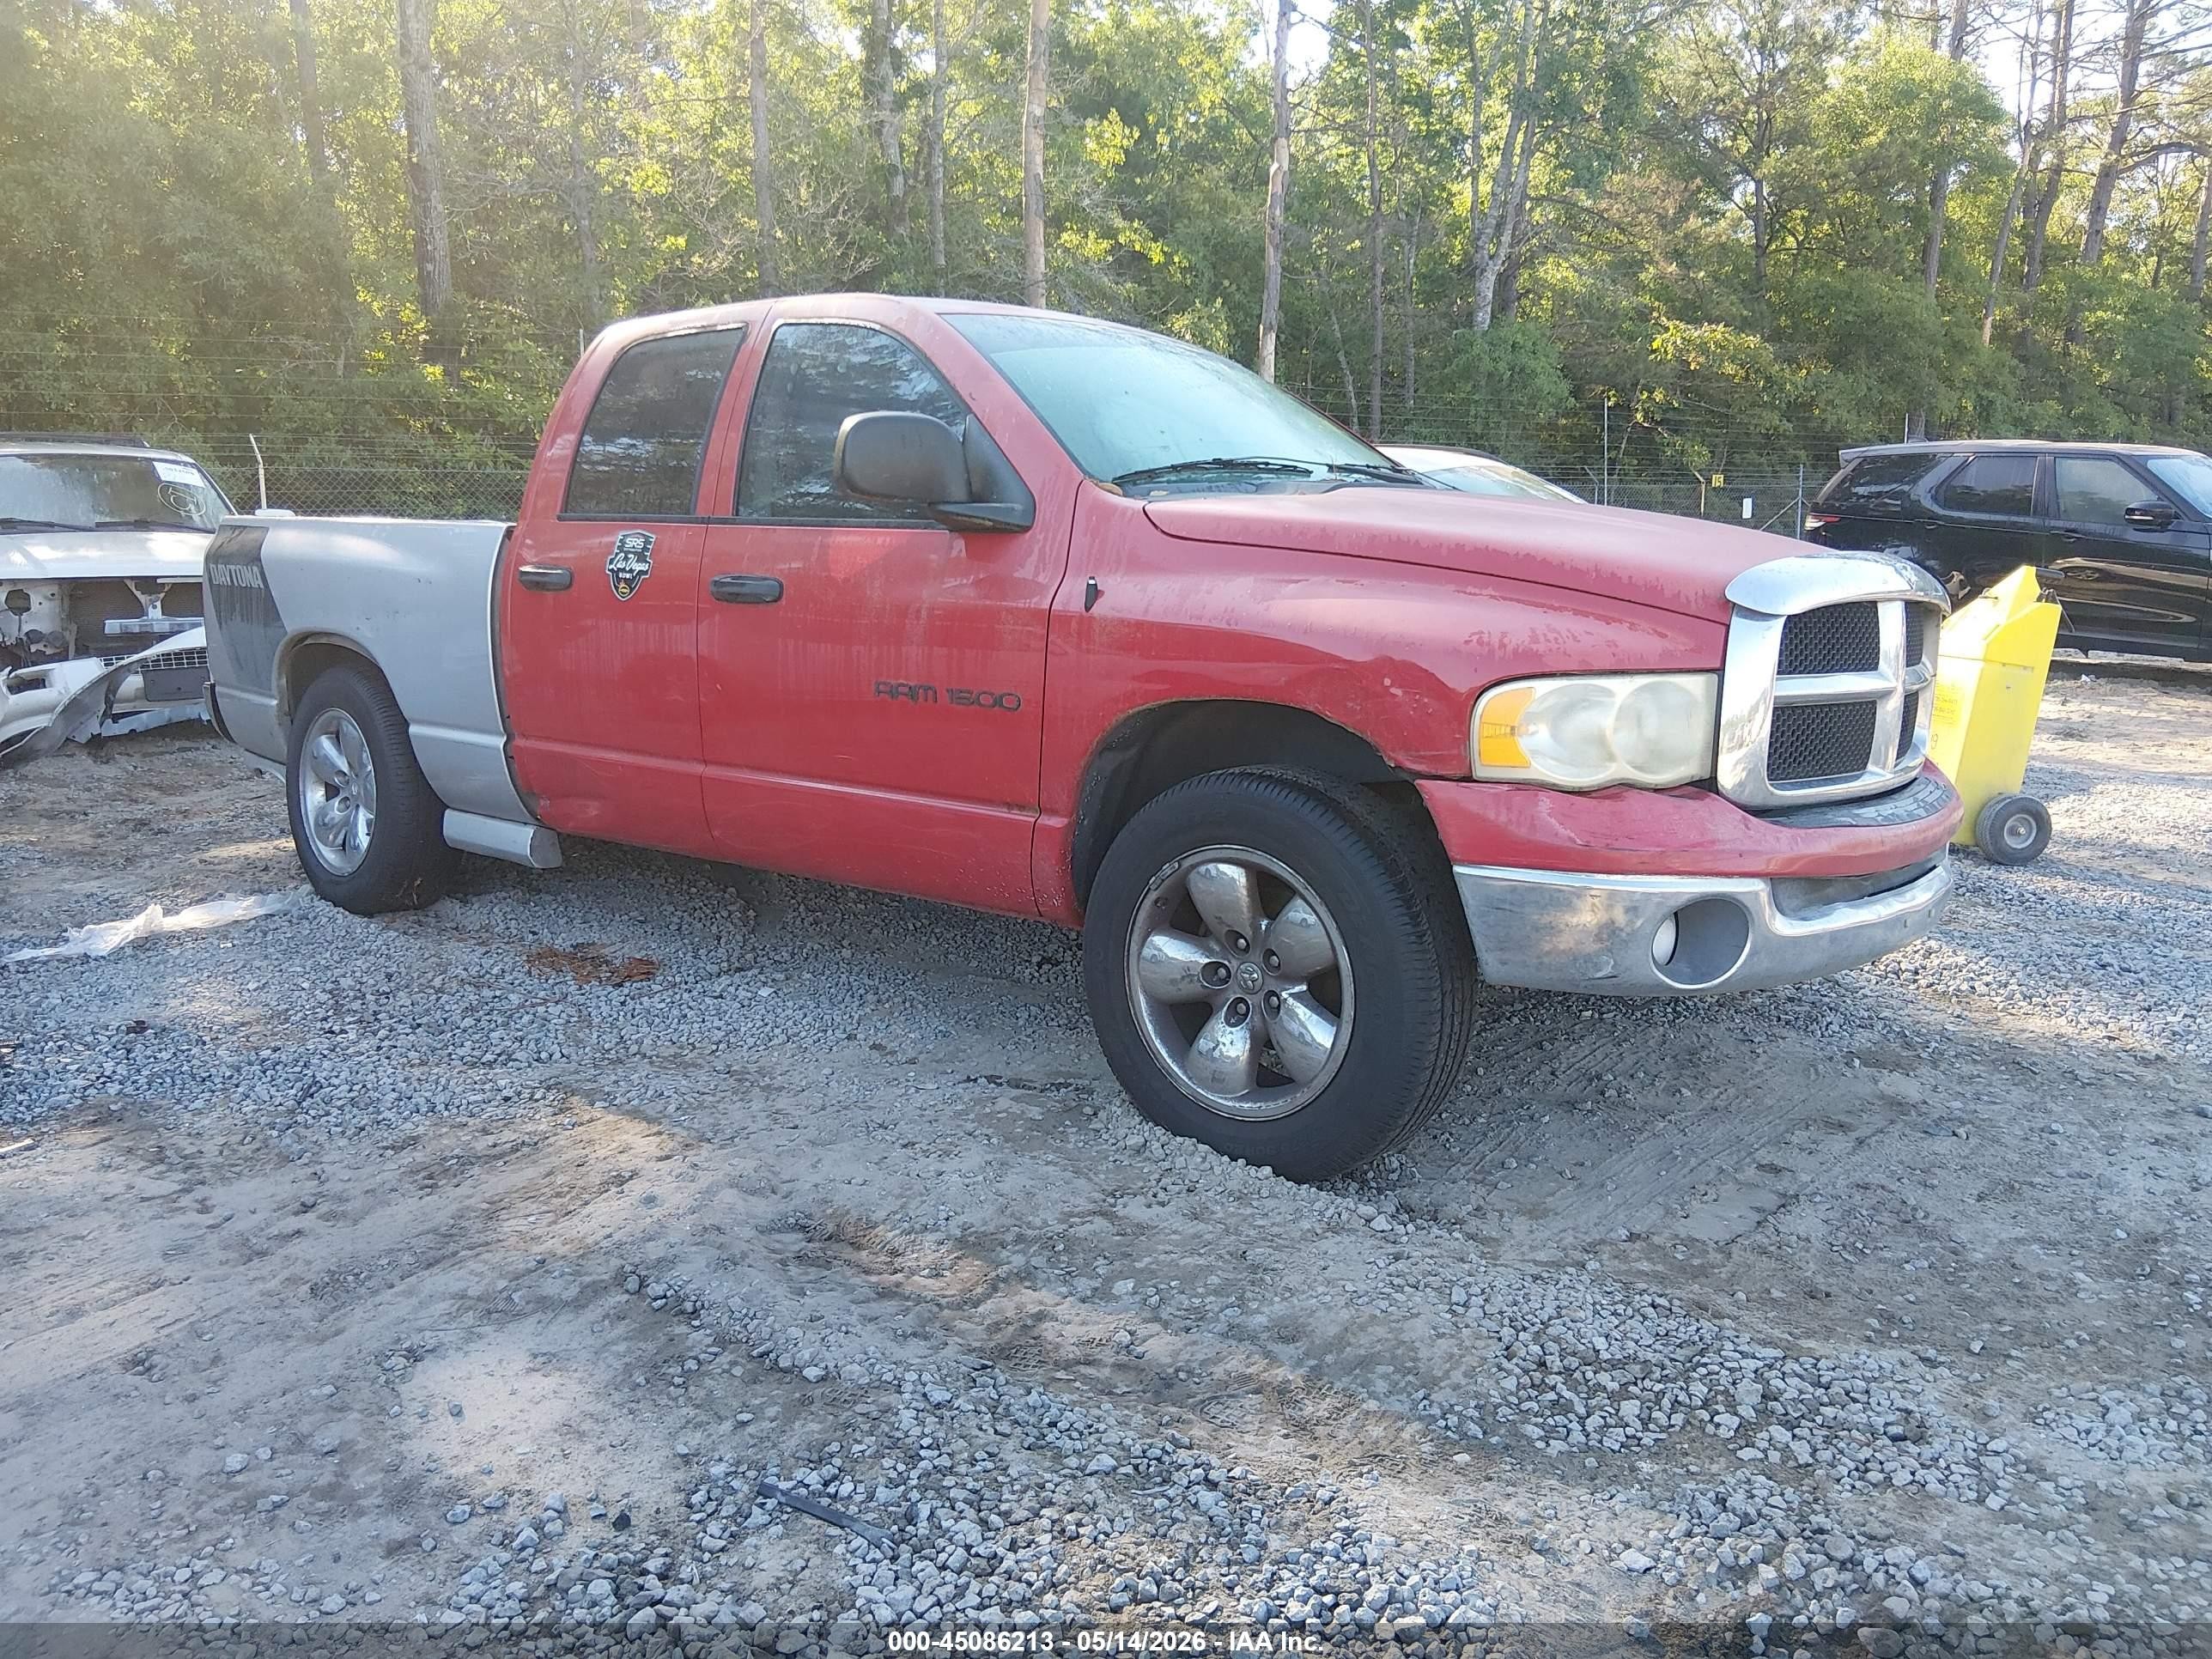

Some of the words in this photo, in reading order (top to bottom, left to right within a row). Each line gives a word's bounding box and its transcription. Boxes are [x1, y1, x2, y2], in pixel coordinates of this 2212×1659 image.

[210, 563, 264, 589] DAYTONA
[608, 553, 626, 571] Las
[625, 554, 650, 577] Vegas
[874, 681, 938, 704] RAM
[945, 688, 1022, 712] 1500
